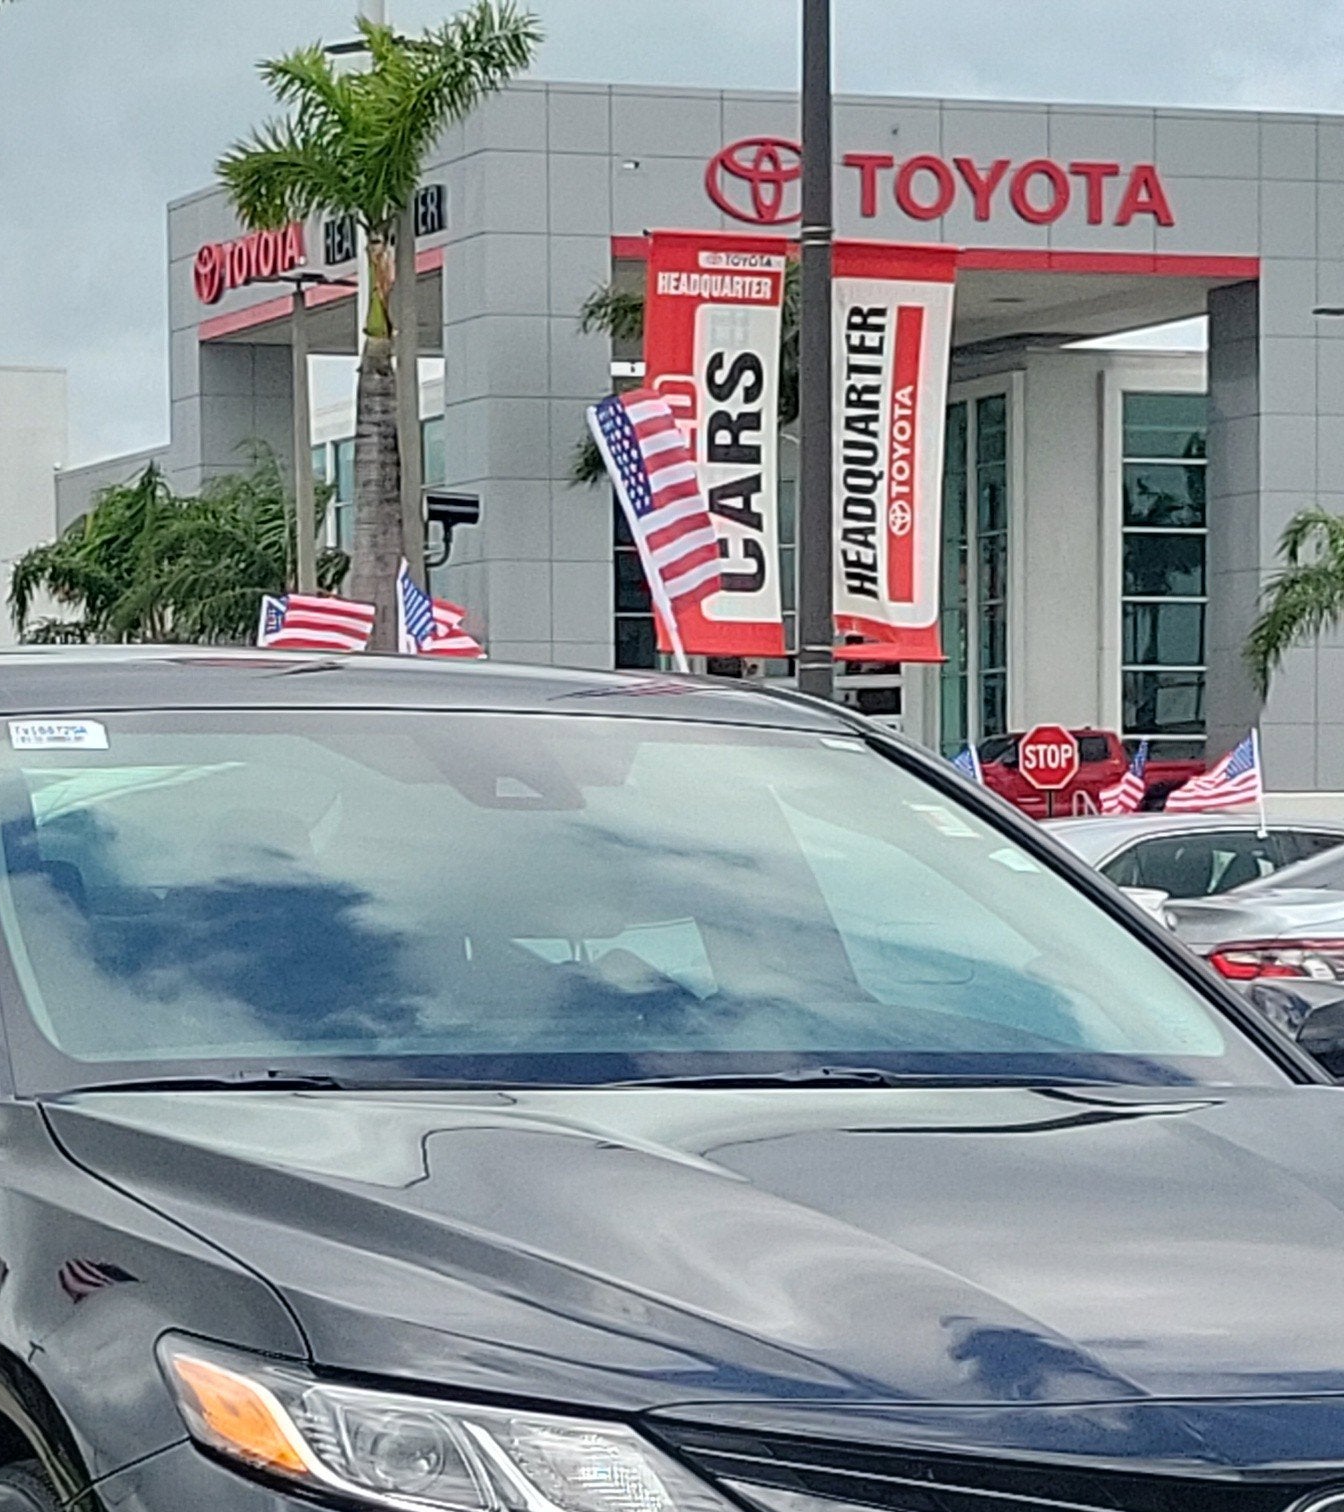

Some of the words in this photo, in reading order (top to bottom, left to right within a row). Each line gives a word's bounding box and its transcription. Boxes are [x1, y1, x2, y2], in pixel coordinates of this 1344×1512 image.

[843, 152, 1174, 227] TOYOTA
[223, 221, 305, 289] TOYOTA
[657, 272, 773, 300] HEADQUARTER
[725, 253, 773, 268] TOYOTA
[706, 351, 766, 593] CARS
[841, 304, 889, 600] HEADQUARTER
[892, 385, 915, 498] TOYOTA
[1024, 743, 1073, 770] STOP
